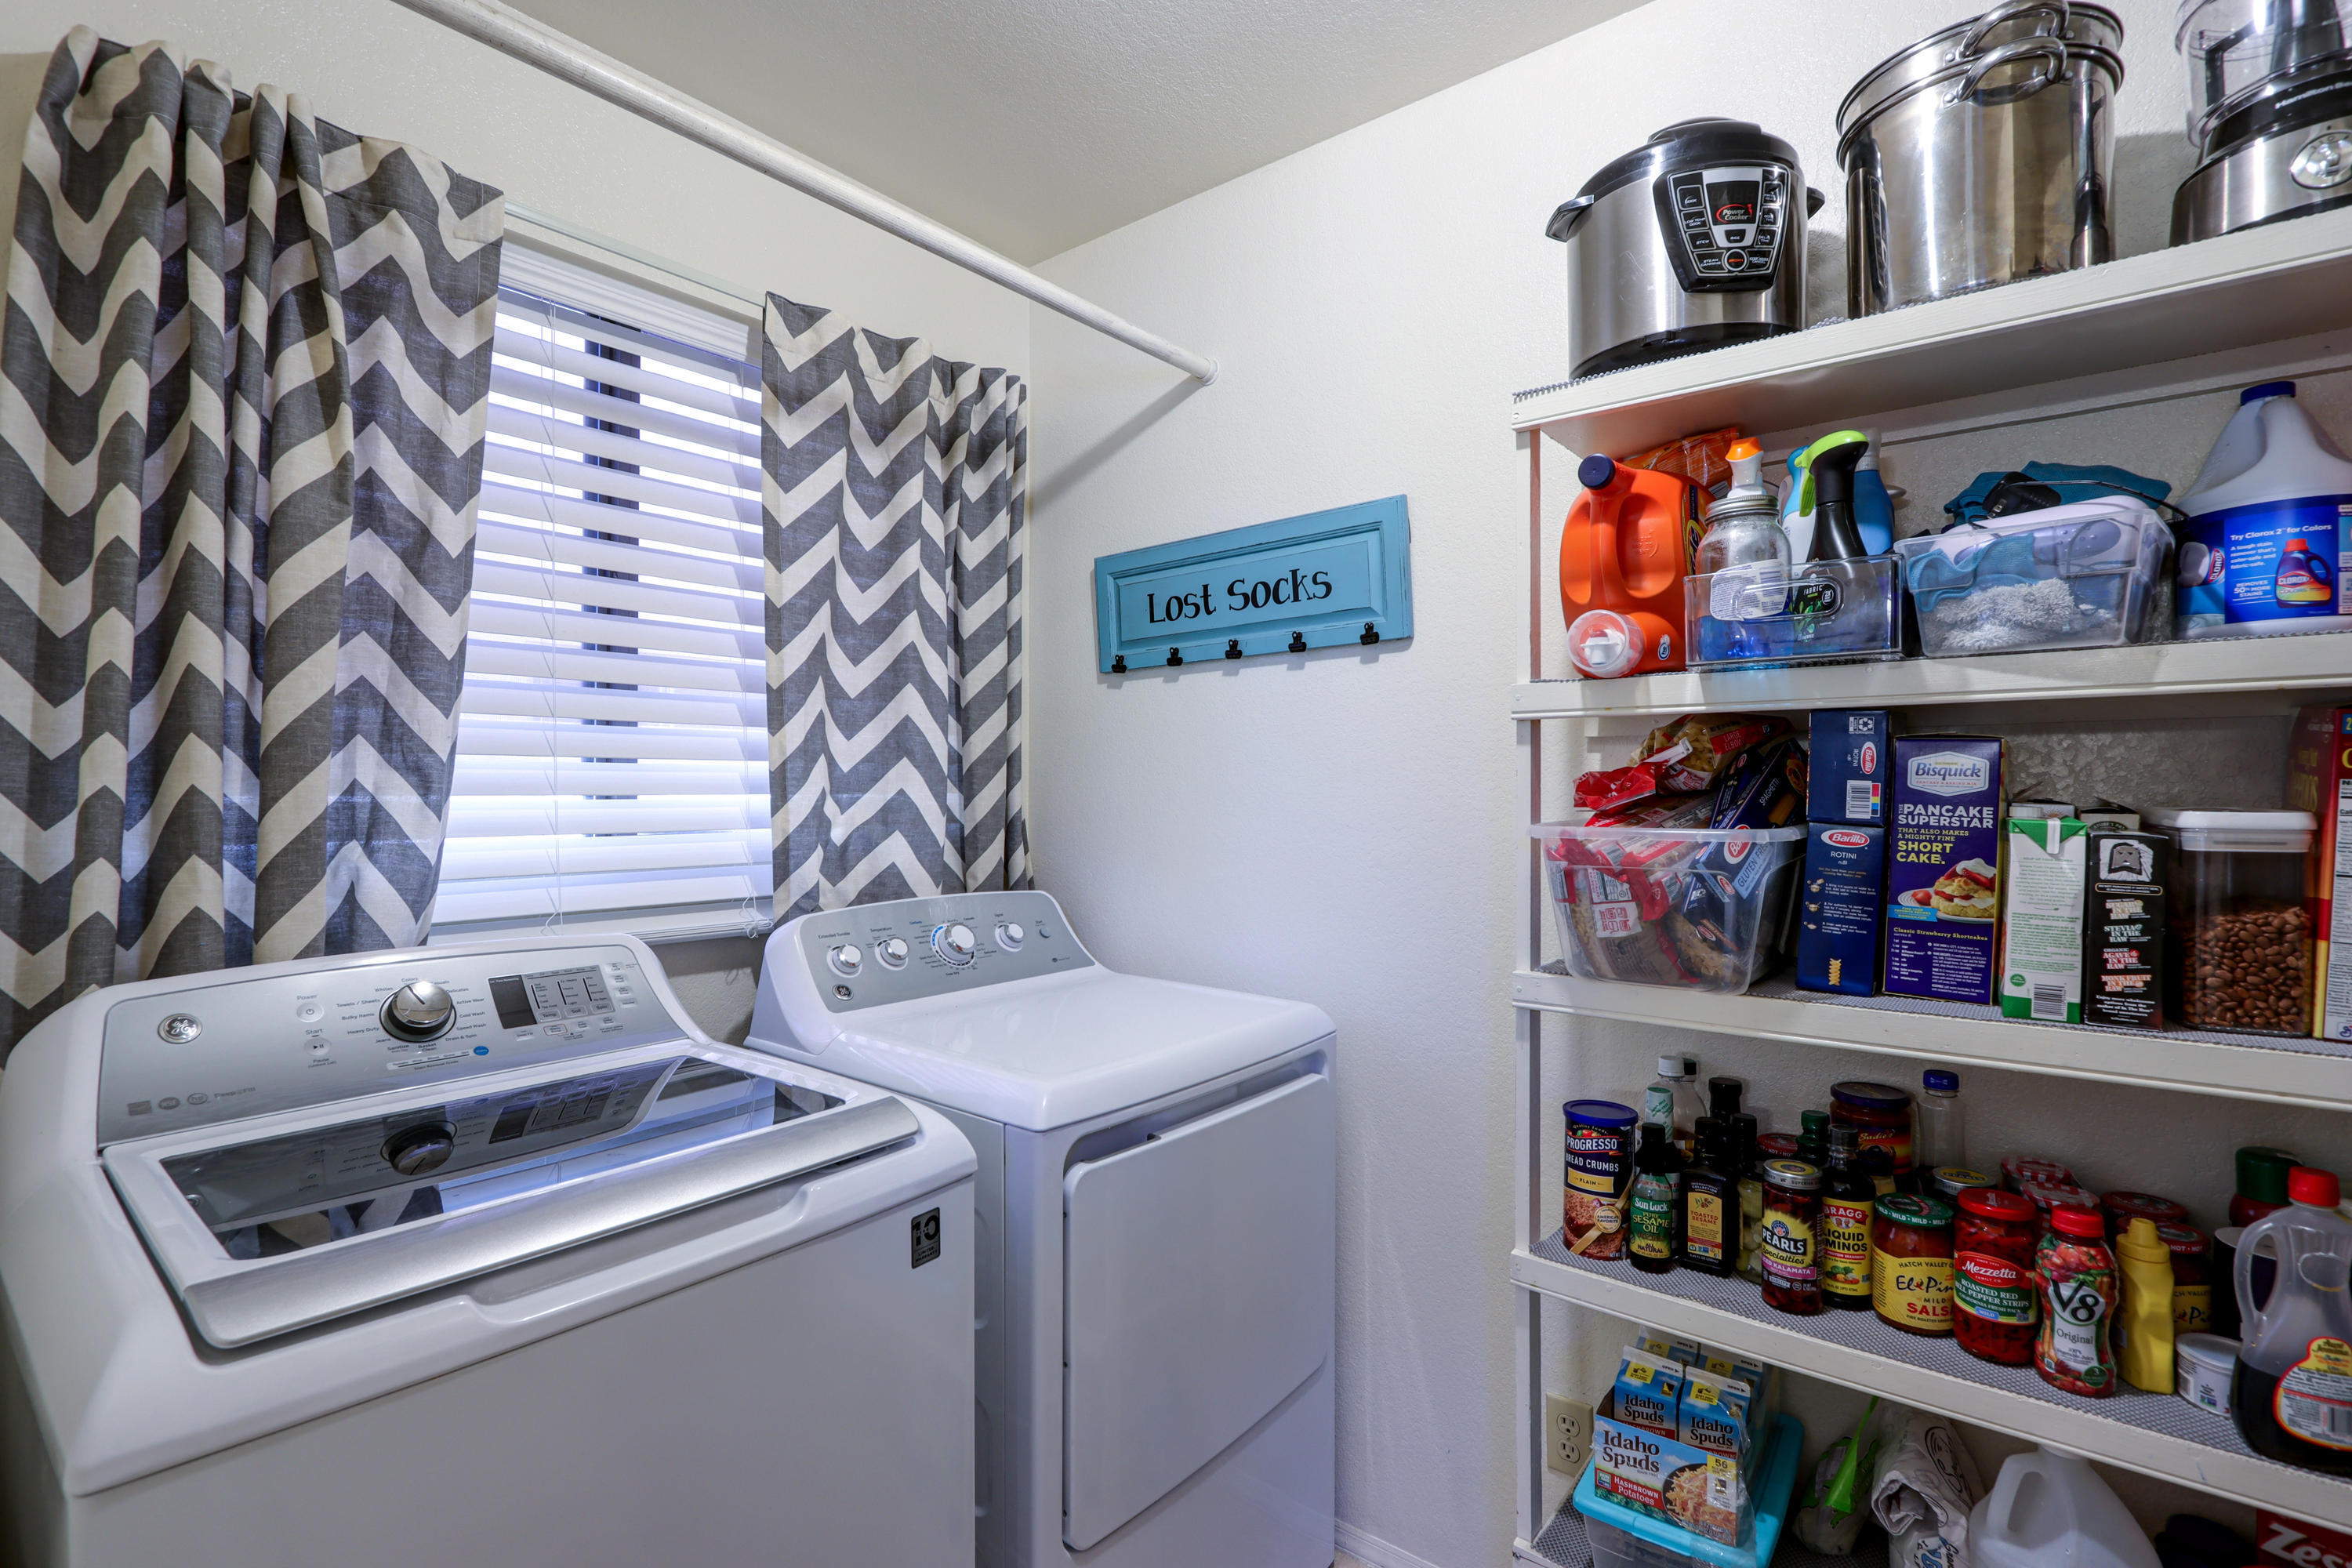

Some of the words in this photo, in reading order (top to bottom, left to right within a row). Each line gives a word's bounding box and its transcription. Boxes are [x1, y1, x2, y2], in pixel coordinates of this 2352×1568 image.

[2274, 85, 2334, 109] Hamilton
[2245, 530, 2274, 539] Clorox
[2211, 551, 2224, 579] CLOROX
[2278, 576, 2310, 585] CLOROX
[1147, 583, 1217, 623] Lost
[1228, 568, 1333, 612] Socks
[1804, 585, 1823, 595] FABRIC
[1723, 731, 1741, 742] LARGE
[1915, 762, 1982, 781] Bisquick
[1759, 778, 1780, 806] SPAGHETTI
[1904, 804, 1994, 818] PANCAKE
[1898, 815, 1994, 829] SUPERSTAR
[1832, 833, 1866, 844] Barilla
[1897, 841, 1954, 853] SHORT
[1896, 852, 1946, 864] CAKE.
[1737, 860, 1757, 887] GLUTEN
[1566, 1135, 1617, 1150] PROGRESSO
[1859, 1129, 1895, 1142] Sadie's
[1566, 1152, 1584, 1167] BREAD
[1586, 1159, 1619, 1172] CRUMBS
[1635, 1197, 1649, 1210] Sun
[1650, 1201, 1668, 1211] Luck
[1690, 1210, 1719, 1221] TOASTED
[1824, 1206, 1862, 1218] BRAGG
[1892, 1212, 1906, 1221] MILD
[1632, 1214, 1669, 1228] SESAME
[1692, 1216, 1717, 1225] SESAME
[1642, 1224, 1659, 1233] OIL
[1762, 1228, 1805, 1253] PEARLS
[1825, 1239, 1867, 1252] MINOS
[1638, 1244, 1664, 1253] NATURAL
[1773, 1263, 1811, 1274] KALAMATA
[1962, 1261, 2016, 1279] Mezzetta
[1896, 1275, 1915, 1290] El
[1926, 1276, 1953, 1293] Pin
[1961, 1279, 1998, 1297] ROASTED
[2000, 1291, 2019, 1300] RED
[1958, 1292, 1987, 1308] CALIFORNIA
[1968, 1288, 2001, 1305] PEPPER
[2049, 1279, 2100, 1323] V8
[1907, 1303, 1953, 1316] SALS
[2057, 1329, 2093, 1344] Original
[1625, 1394, 1664, 1410] Idaho
[1624, 1406, 1664, 1423] Spuds
[1691, 1417, 1733, 1434] Idaho
[1603, 1430, 1660, 1455] Idaho
[1691, 1429, 1733, 1446] Spuds
[1602, 1447, 1660, 1472] Spuds
[1715, 1458, 1728, 1468] 56
[1614, 1476, 1659, 1499] HASHBROWN
[1618, 1486, 1655, 1506] Potatoes
[2260, 1522, 2352, 1568] Zes
